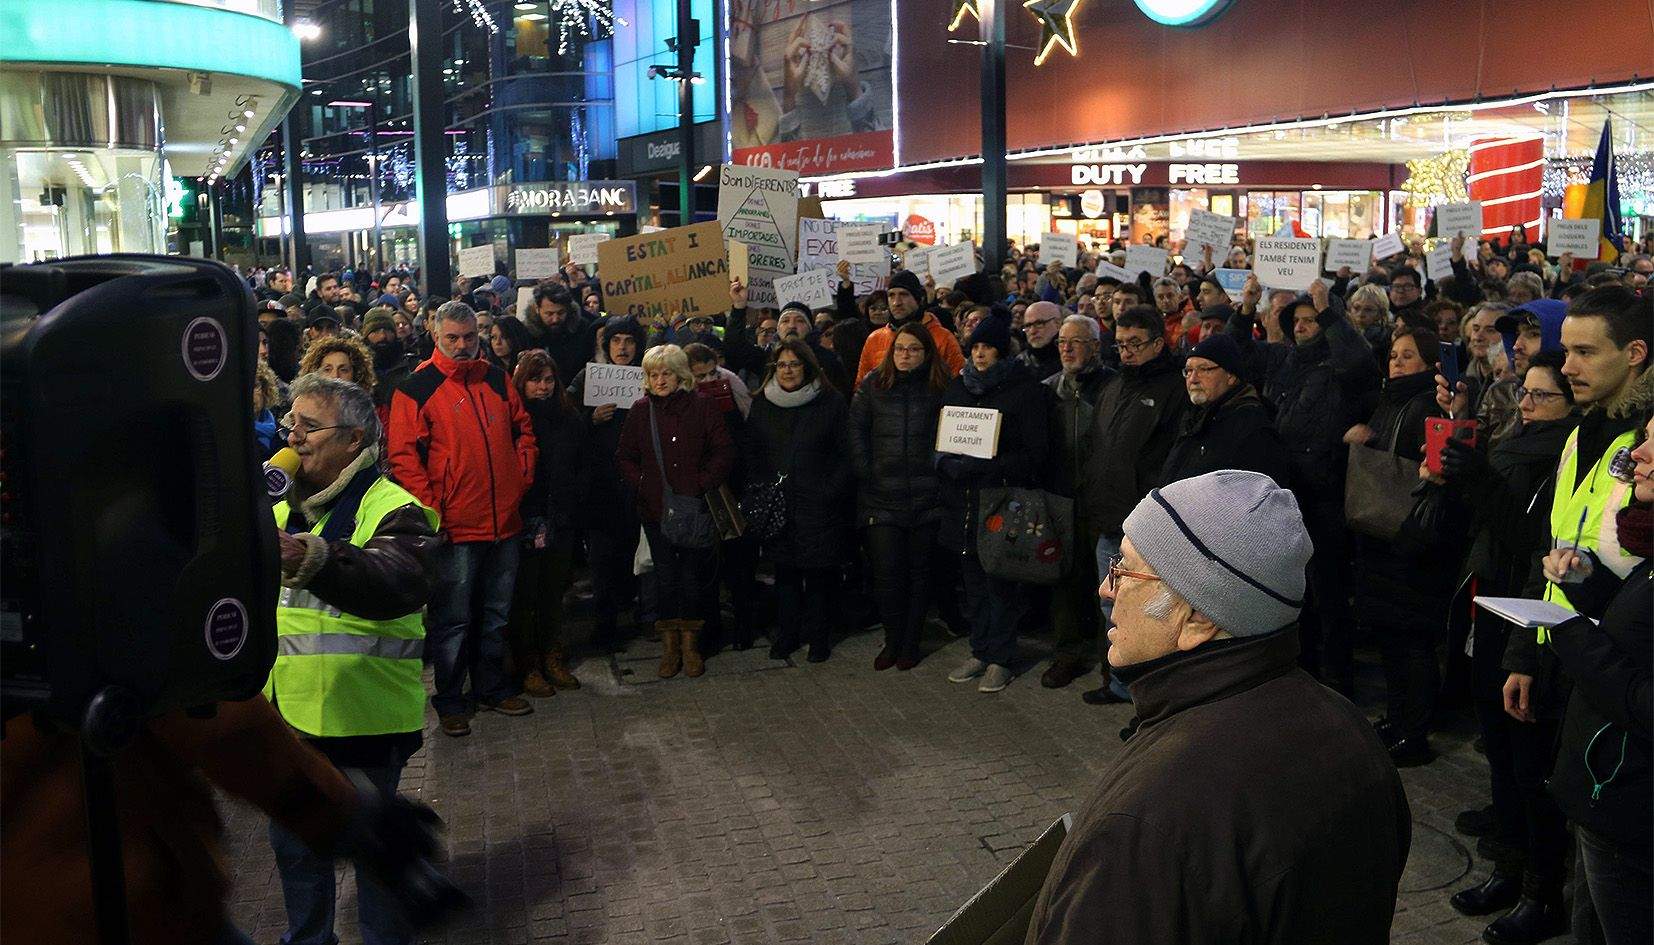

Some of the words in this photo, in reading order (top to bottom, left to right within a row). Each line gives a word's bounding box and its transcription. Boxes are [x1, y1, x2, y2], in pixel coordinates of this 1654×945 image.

[648, 141, 680, 160] Desigua
[1071, 164, 1147, 185] DUTY
[1169, 163, 1240, 184] FREE
[803, 220, 820, 233] NO
[727, 227, 779, 244] IMPORTADES
[627, 236, 677, 263] ESTAT
[688, 232, 699, 249] I
[1259, 241, 1272, 250] ELS
[1273, 241, 1317, 251] RESIDENTS
[1259, 254, 1286, 263] TAMBÉ
[1286, 255, 1315, 264] TENIM
[1277, 268, 1294, 276] VEU
[590, 366, 644, 381] PENSIONS
[946, 410, 994, 420] AVORTAMENT
[956, 423, 979, 432] LLIURE
